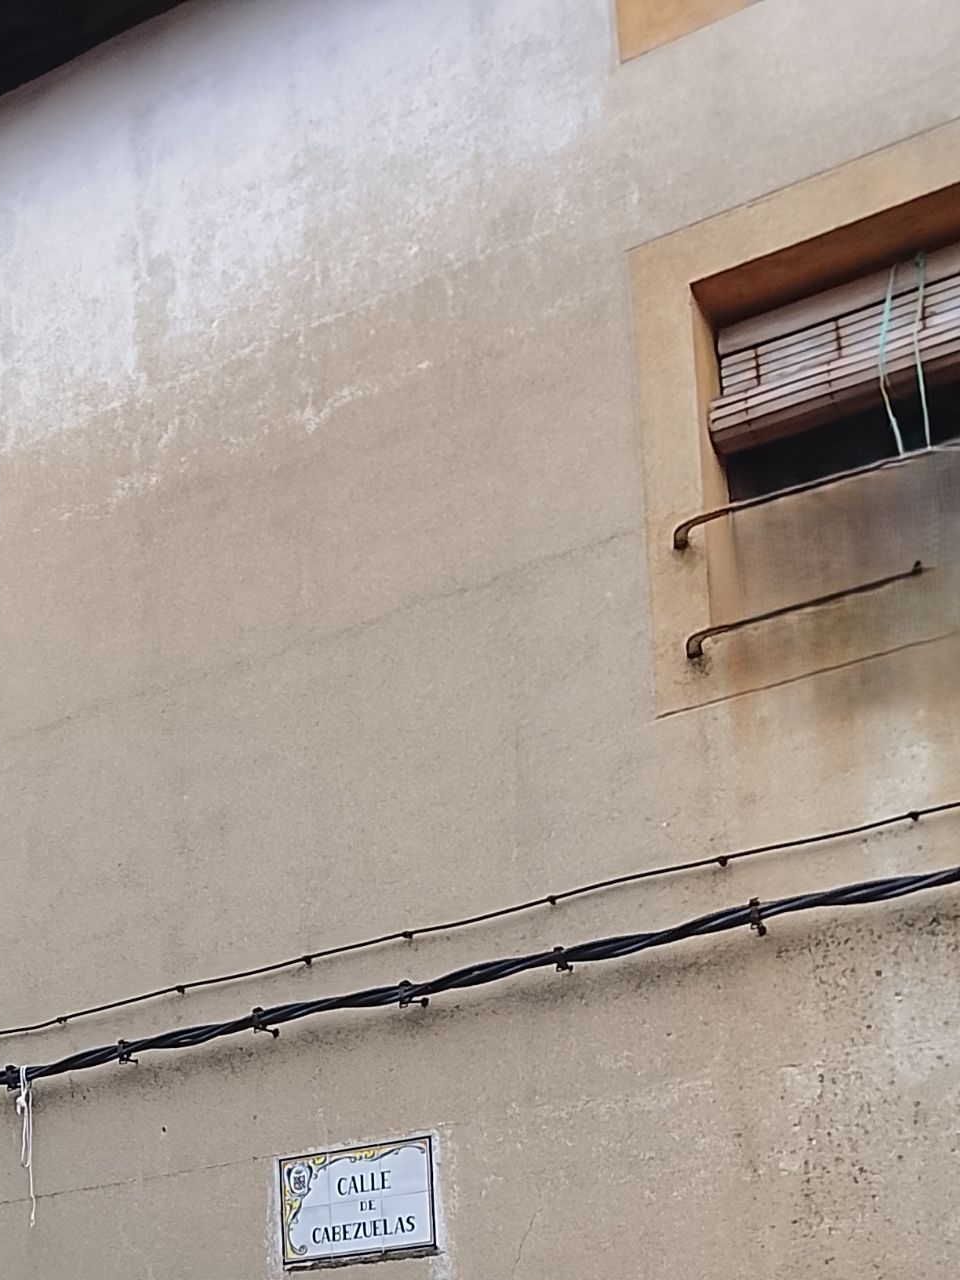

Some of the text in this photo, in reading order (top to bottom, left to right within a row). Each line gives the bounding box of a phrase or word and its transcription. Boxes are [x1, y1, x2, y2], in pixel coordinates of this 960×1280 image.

[337, 1170, 391, 1196] CALLE
[359, 1200, 376, 1211] DE
[312, 1215, 416, 1244] CABEZUELAS
